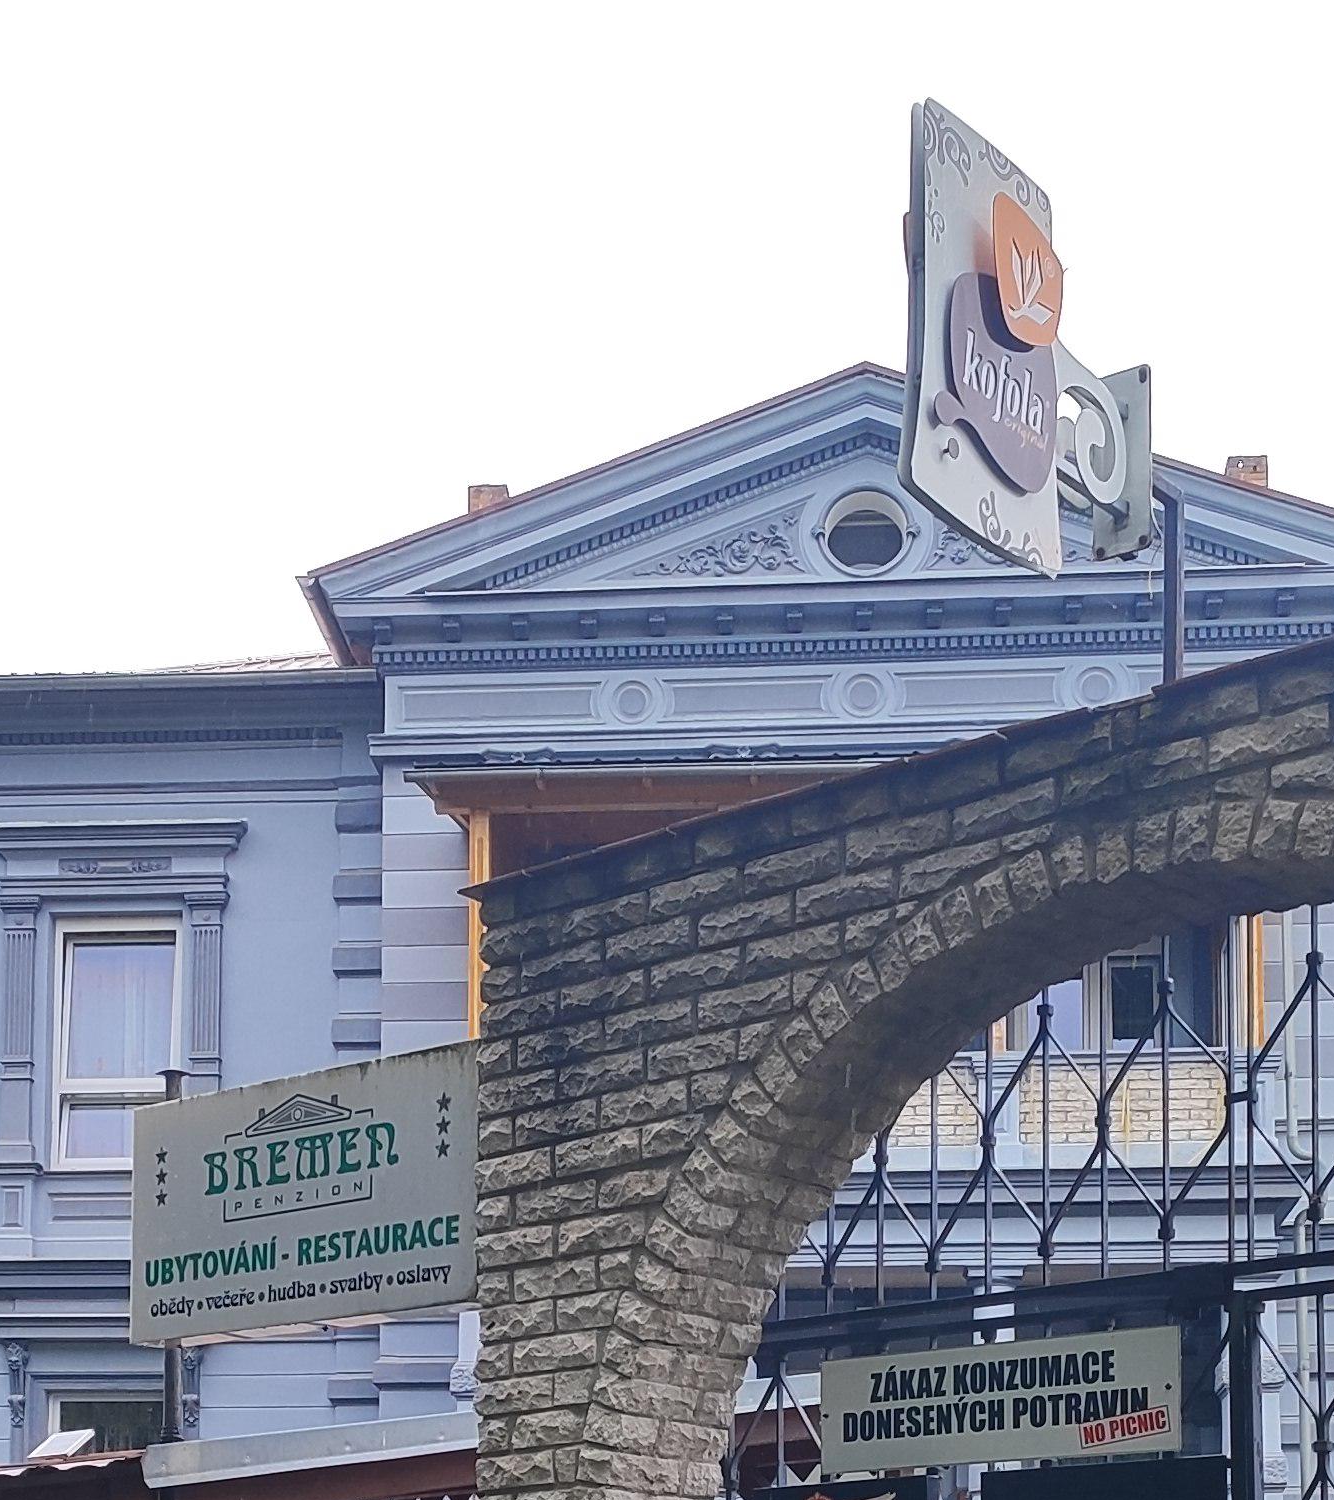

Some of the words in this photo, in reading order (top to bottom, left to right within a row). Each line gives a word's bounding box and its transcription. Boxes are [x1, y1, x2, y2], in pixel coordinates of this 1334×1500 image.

[963, 328, 1045, 435] kofola
[203, 1122, 399, 1196] BREMEN
[234, 1181, 364, 1212] PENZION
[145, 1236, 277, 1288] UBYTOVÁNÍ
[297, 1214, 460, 1266] RESTAURACE
[150, 1291, 195, 1318] obědy
[205, 1288, 255, 1311] večeře
[268, 1280, 316, 1302] hudba
[329, 1271, 383, 1296] svatby
[396, 1264, 452, 1286] oslavy
[870, 1365, 947, 1403] ZÁKAZ
[953, 1350, 1115, 1395] KONZUMACE
[842, 1398, 1004, 1443] DONESENÝCH
[1012, 1387, 1148, 1429] POTRAVIN
[1083, 1423, 1106, 1445] NO
[1109, 1410, 1167, 1440] PICNIC
